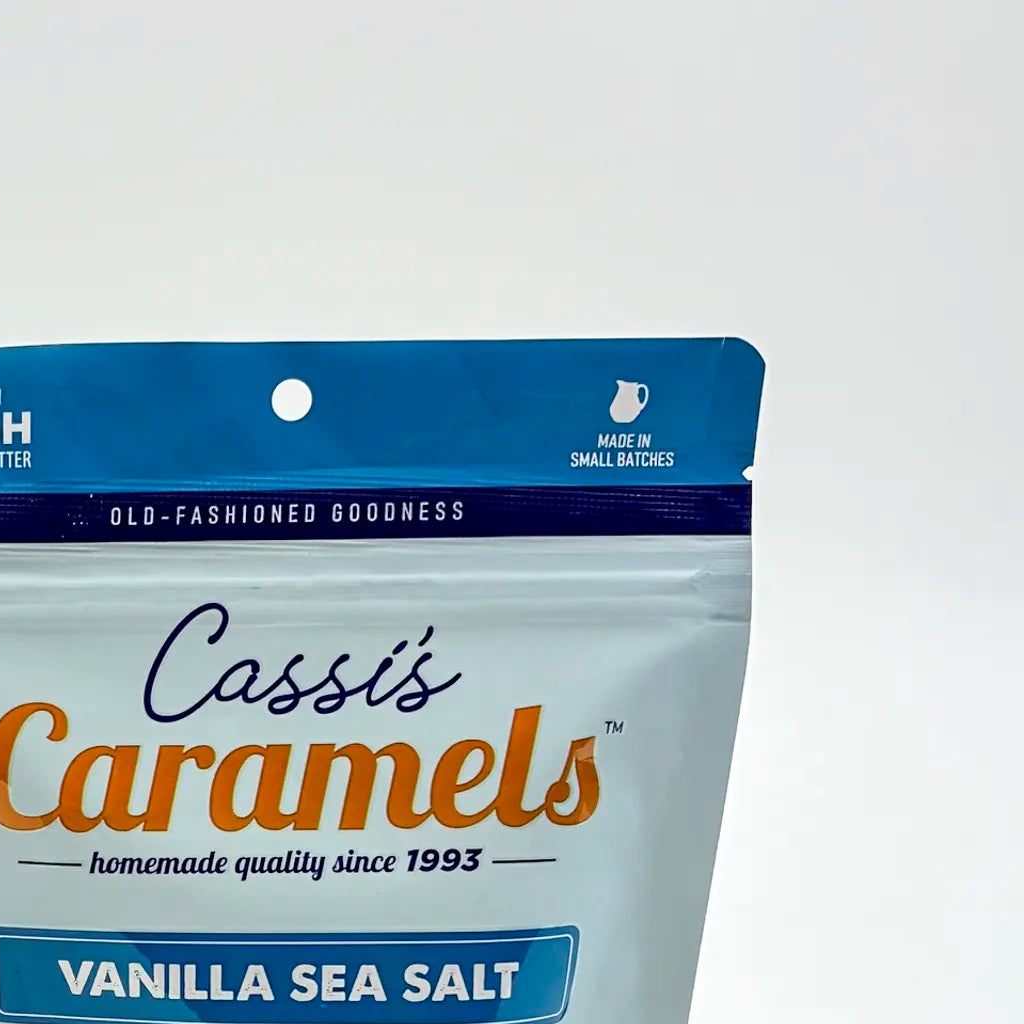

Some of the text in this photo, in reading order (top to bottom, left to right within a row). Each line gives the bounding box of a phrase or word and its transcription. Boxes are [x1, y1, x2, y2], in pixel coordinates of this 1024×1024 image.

[597, 433, 651, 449] MADE IN
[570, 451, 674, 467] SMALL BATCHES
[110, 501, 465, 526] OLD-FASHIONED GOODNESS
[143, 602, 463, 724] Cassi's
[89, 848, 483, 882] homemade quality since 1993
[57, 959, 520, 1002] VANILLA SEA SALT
